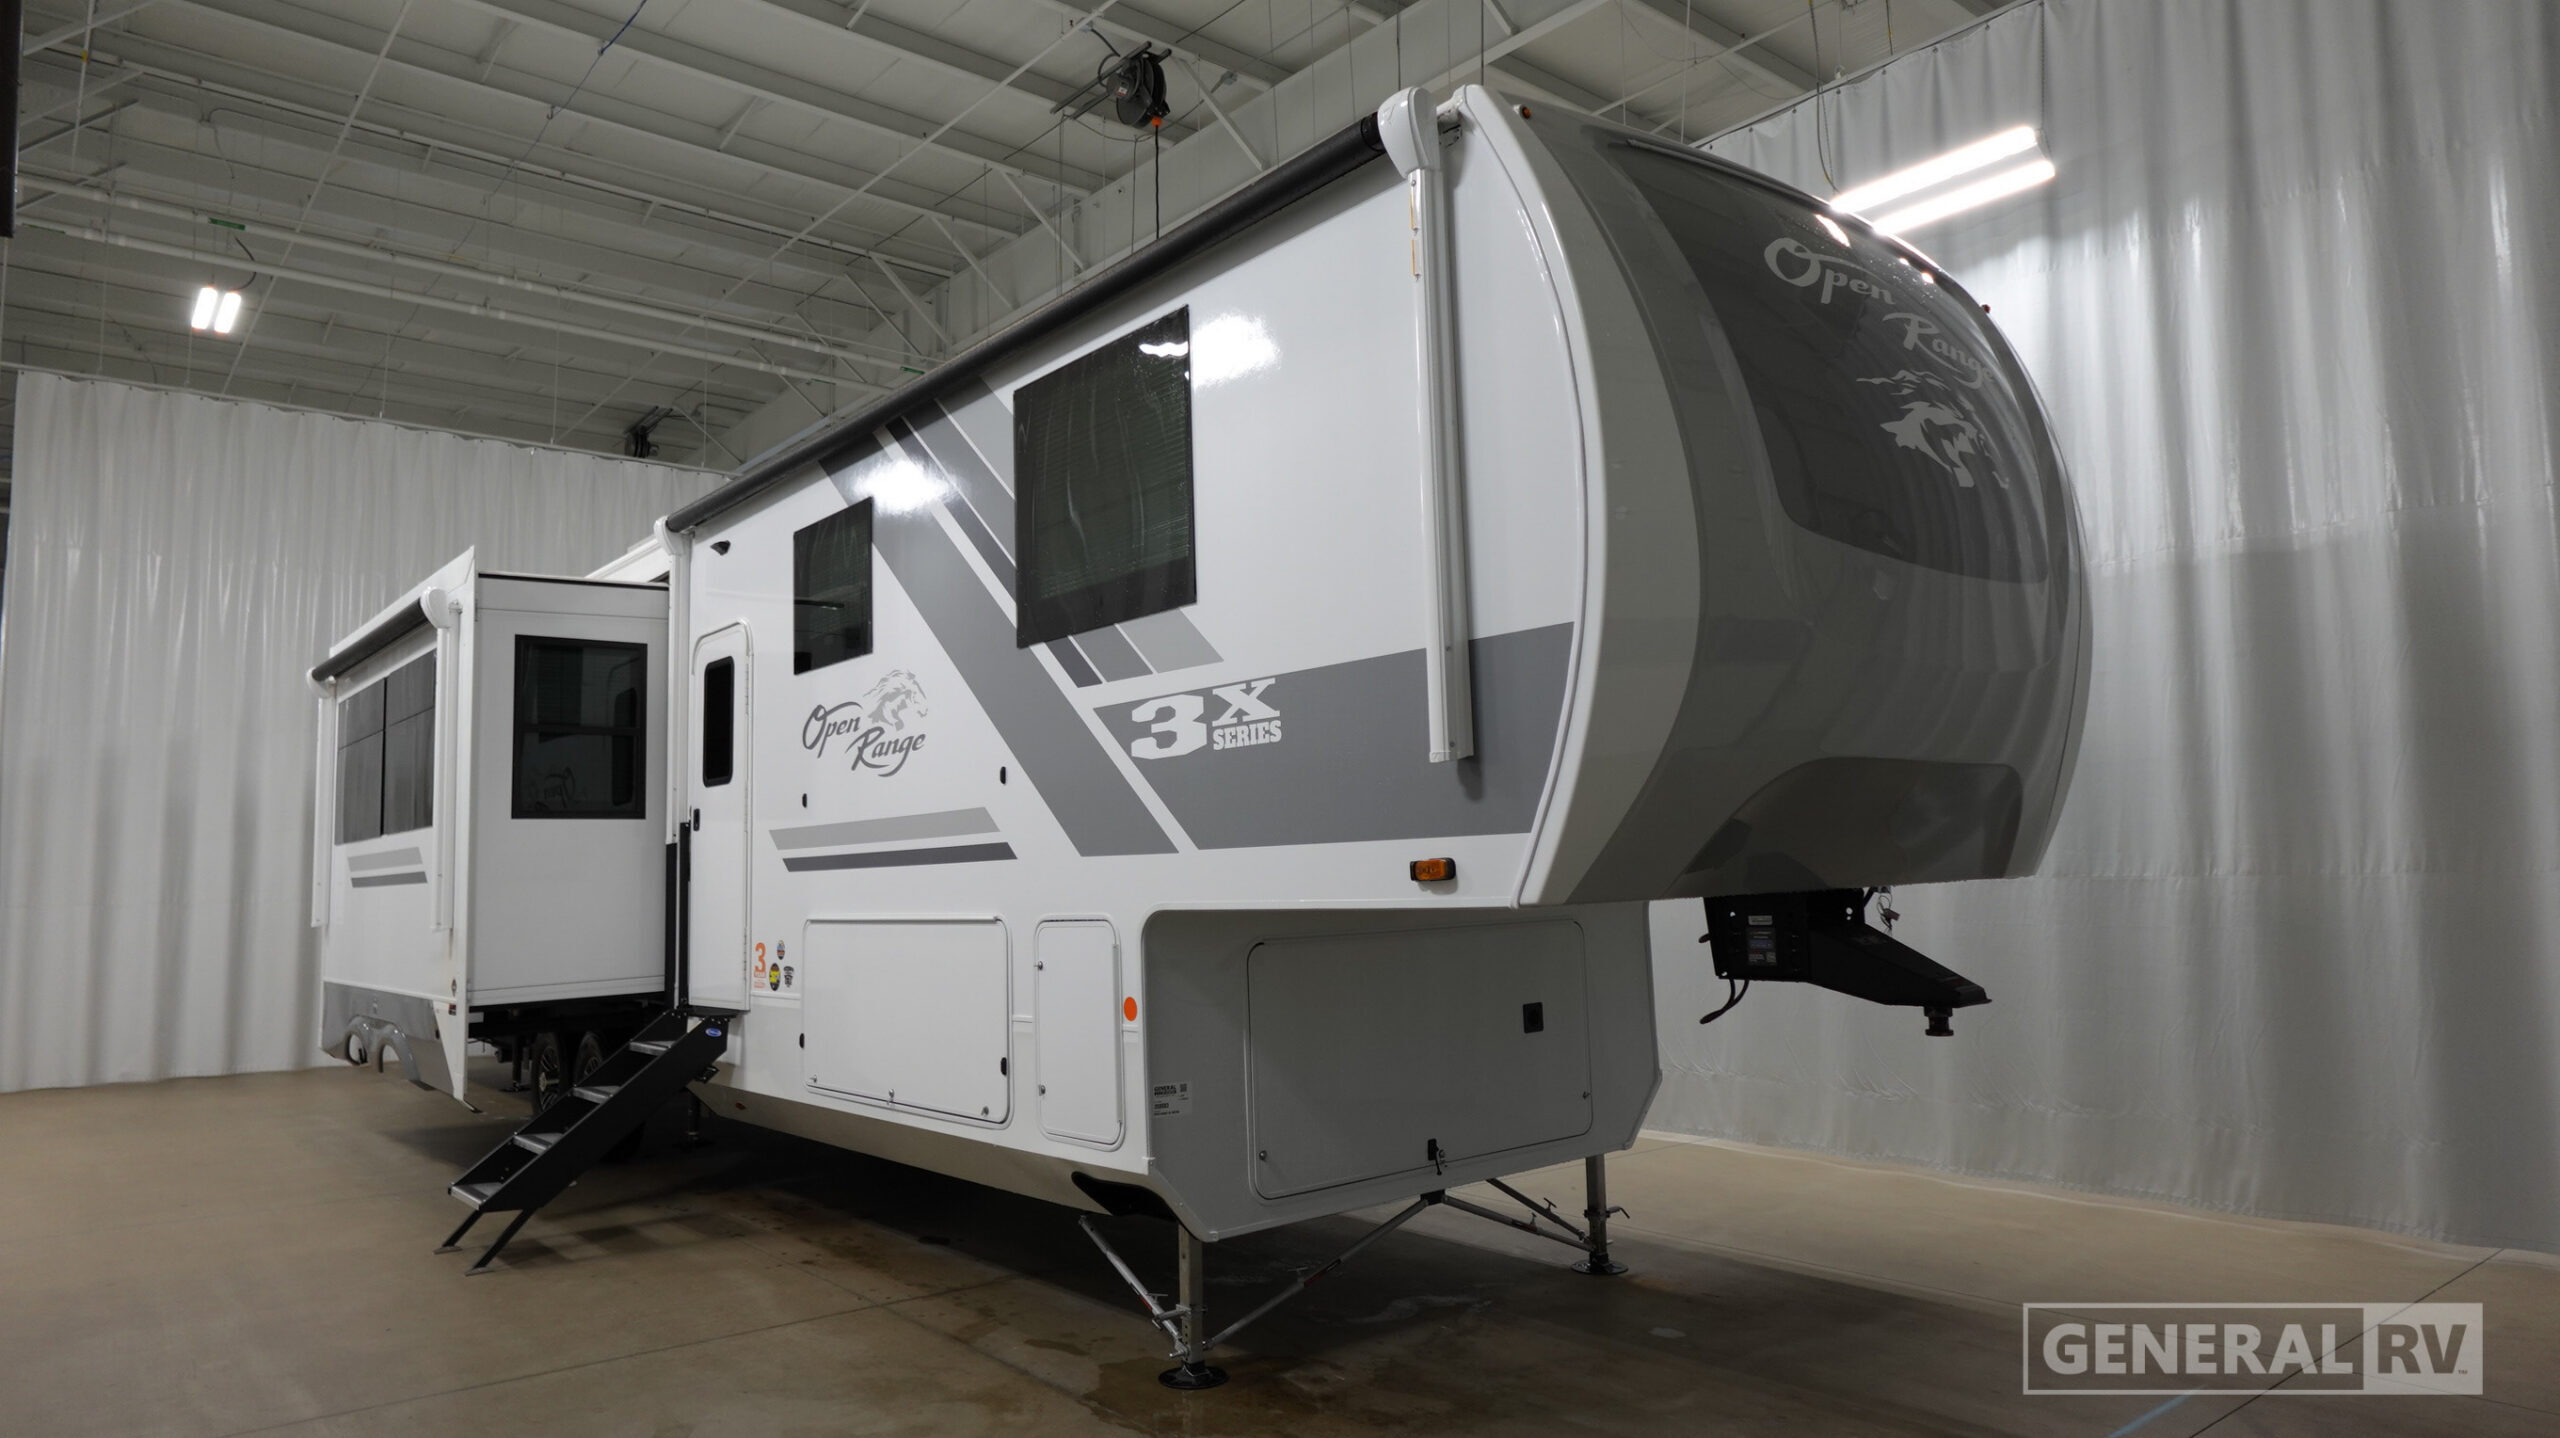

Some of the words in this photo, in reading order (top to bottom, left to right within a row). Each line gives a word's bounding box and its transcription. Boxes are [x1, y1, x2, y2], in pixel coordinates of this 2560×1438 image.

[1763, 237, 1896, 305] Open
[1882, 312, 1997, 389] Range
[802, 701, 864, 759] Open
[844, 726, 927, 778] Range
[1212, 720, 1282, 750] SERIES
[754, 942, 767, 972] 3
